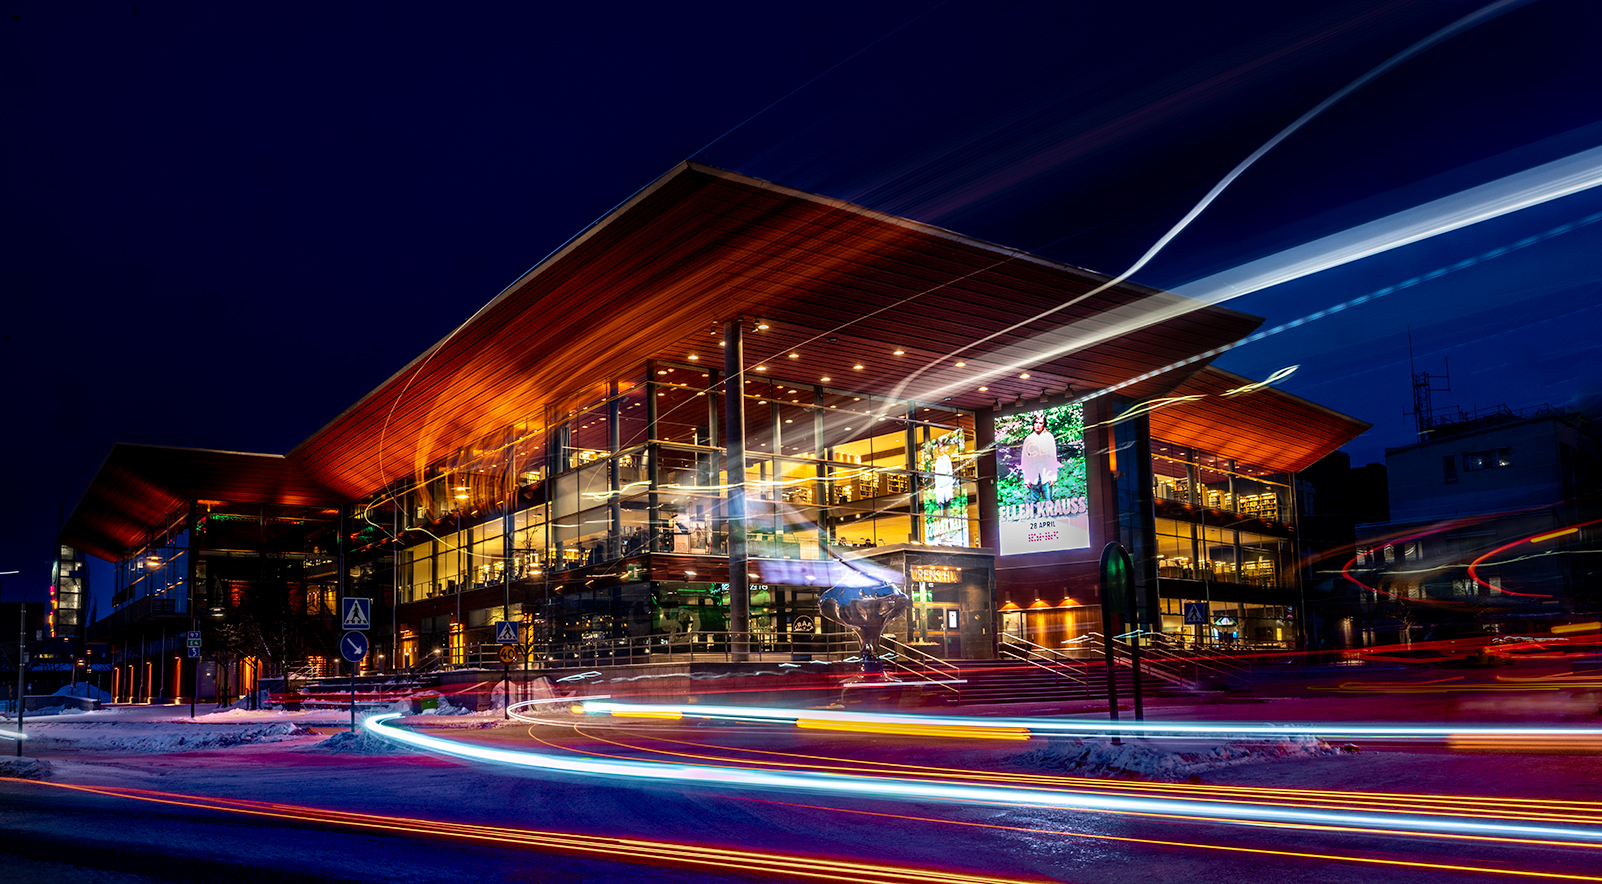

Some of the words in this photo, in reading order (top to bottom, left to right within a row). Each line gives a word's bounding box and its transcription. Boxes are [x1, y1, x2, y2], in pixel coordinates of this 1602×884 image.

[1000, 502, 1035, 521] ELLEN
[1037, 496, 1087, 518] KRAUSS
[1030, 522, 1038, 530] 28
[501, 649, 514, 660] 40
